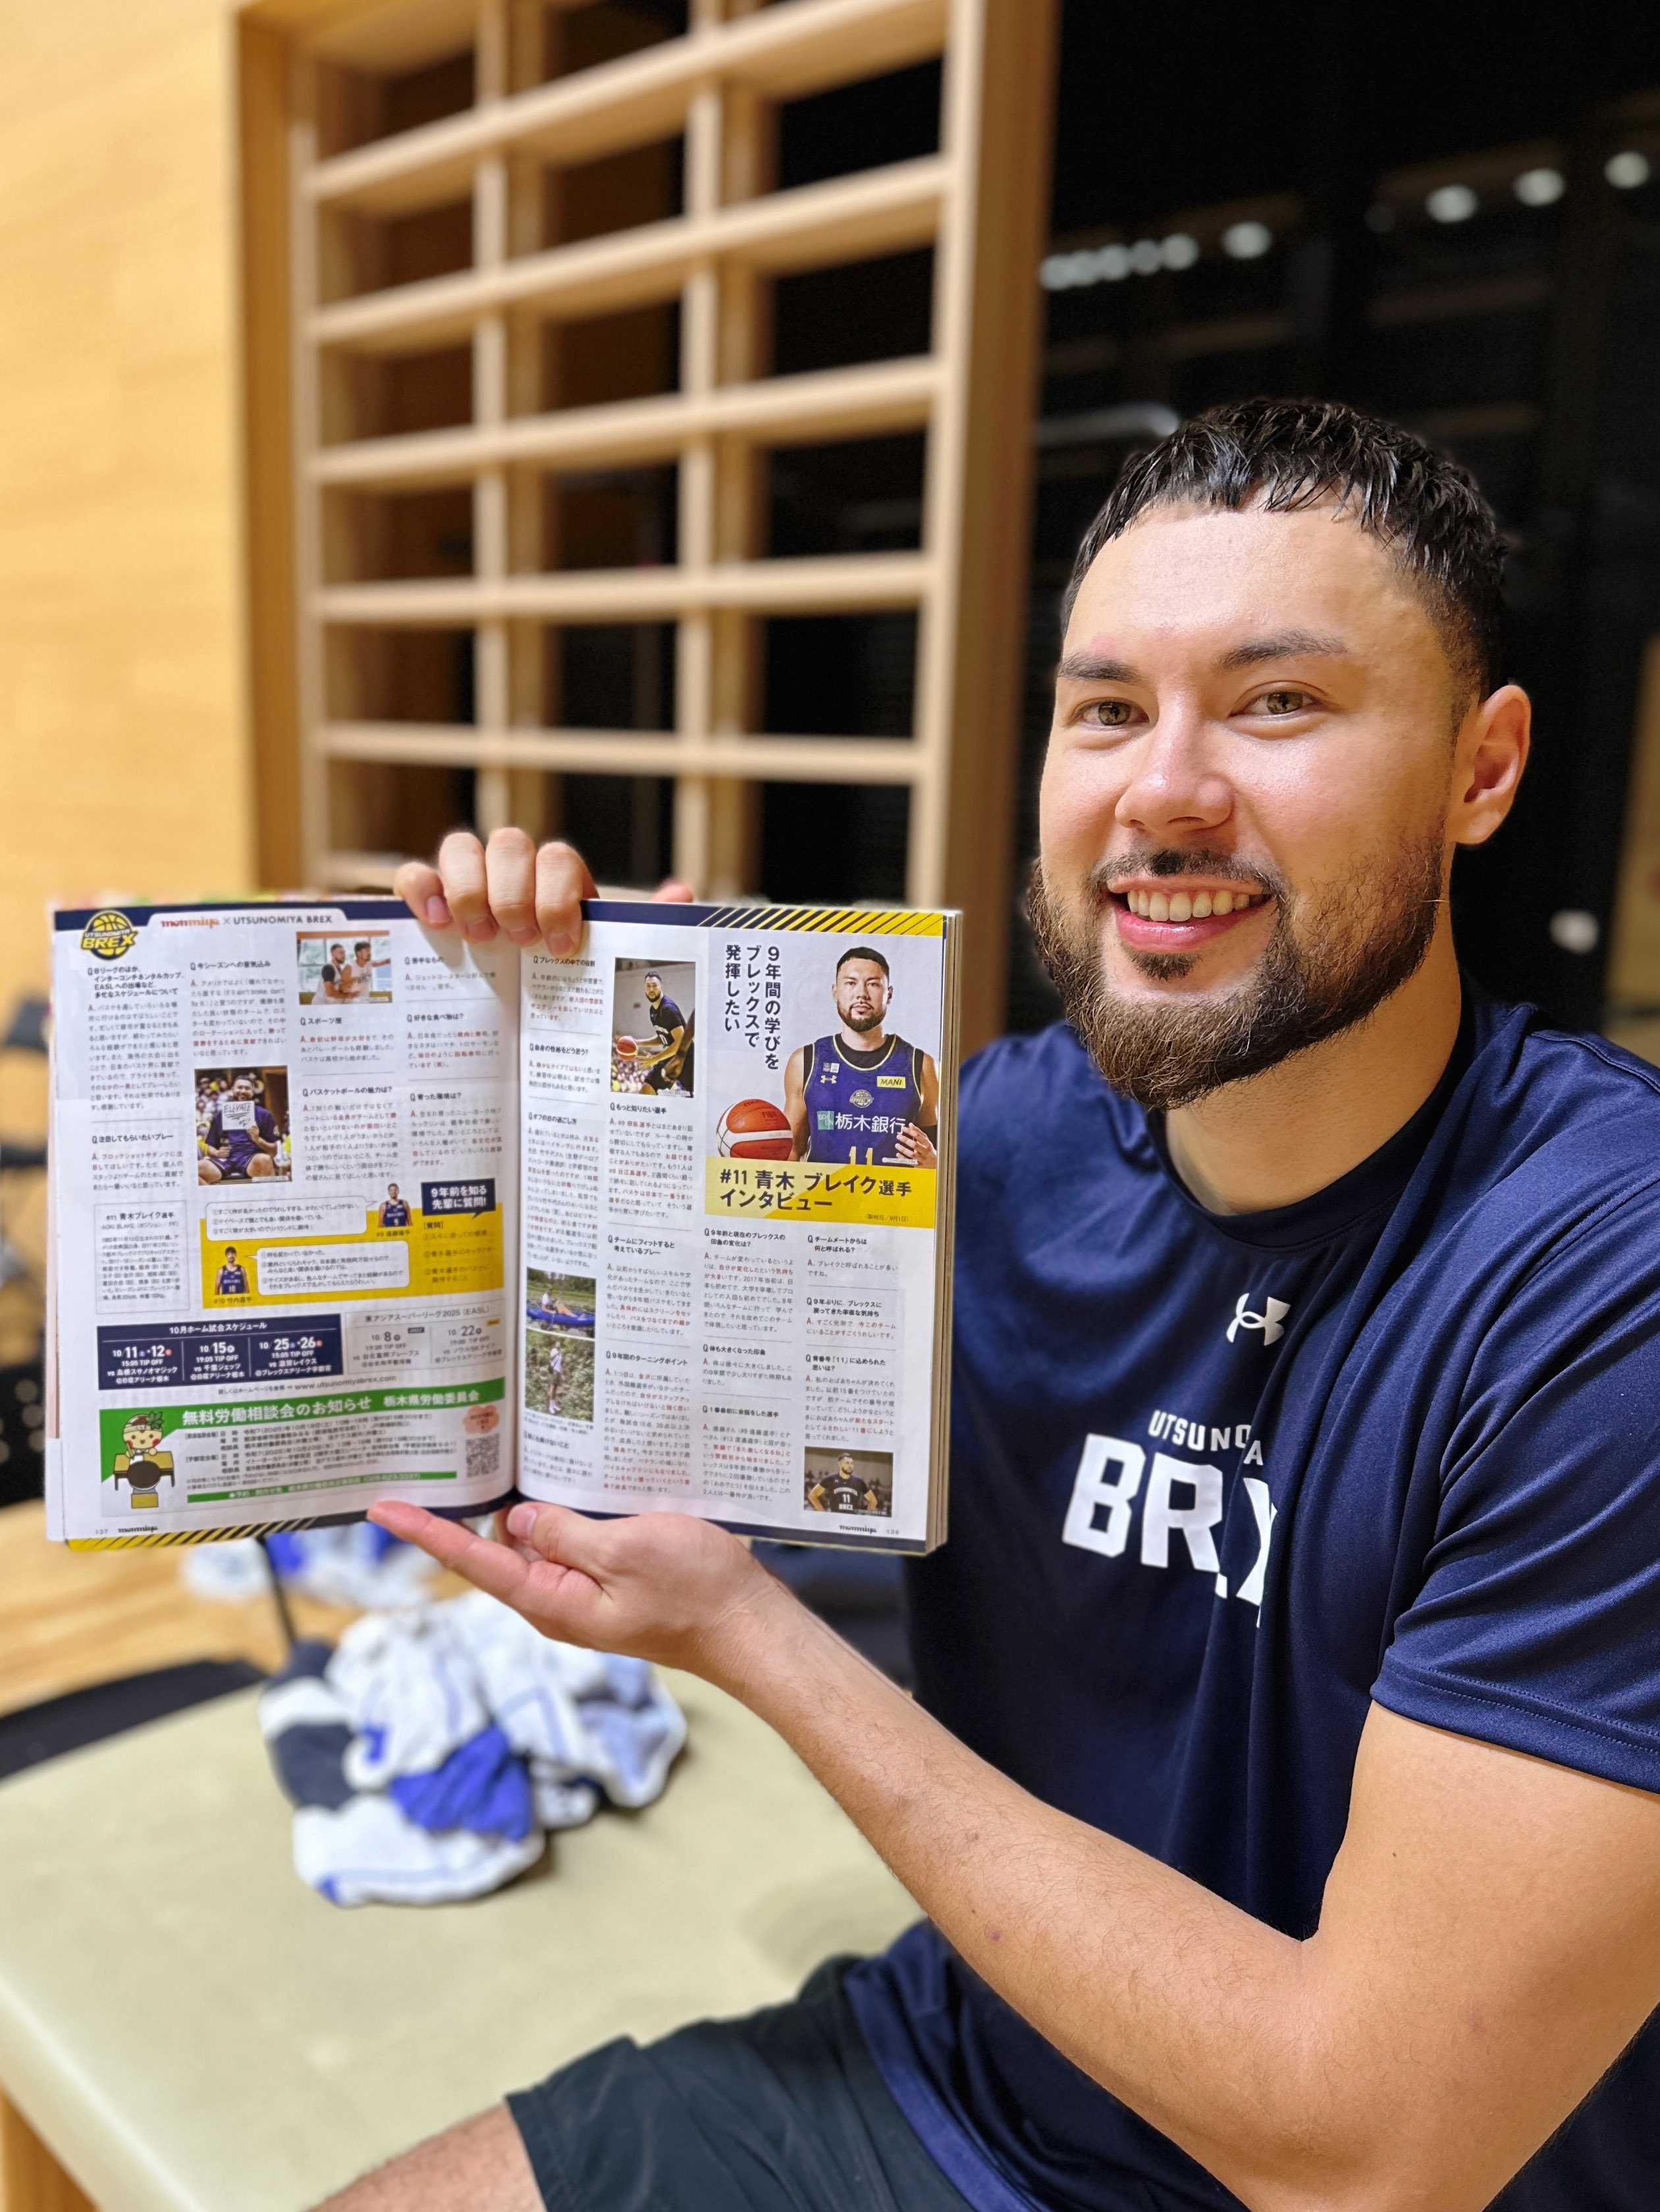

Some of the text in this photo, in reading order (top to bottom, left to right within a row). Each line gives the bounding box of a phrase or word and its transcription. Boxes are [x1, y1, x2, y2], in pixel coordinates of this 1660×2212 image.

[233, 916, 303, 925] UTSUNOMIYA
[306, 915, 333, 924] BREX
[82, 931, 137, 949] BREX
[724, 944, 741, 1032] 発揮したい
[744, 945, 762, 1048] ブレックスで
[764, 945, 782, 1070] 9年間の学びを
[835, 1112, 906, 1134] 栃木銀行
[720, 1169, 913, 1197] #11 青木 ブレイク選手
[431, 1185, 487, 1198] 9年前を知る
[720, 1188, 833, 1211] インタビュー
[711, 1230, 786, 1240] 9年前と現在のブレックスの
[815, 1236, 867, 1245] チームメートからは
[614, 1236, 676, 1249] チームにフィットすると
[614, 1246, 661, 1255] 考えているプレー
[710, 1345, 766, 1356] 体も大きくなった印象
[612, 1353, 688, 1365] 9年間のターニングポイント
[294, 1375, 396, 1391] www.utsunomiyabrex.com
[182, 1390, 479, 1426] 無料労働相談会のお知らせ 栃木県労働委員会
[843, 1494, 851, 1504] 11
